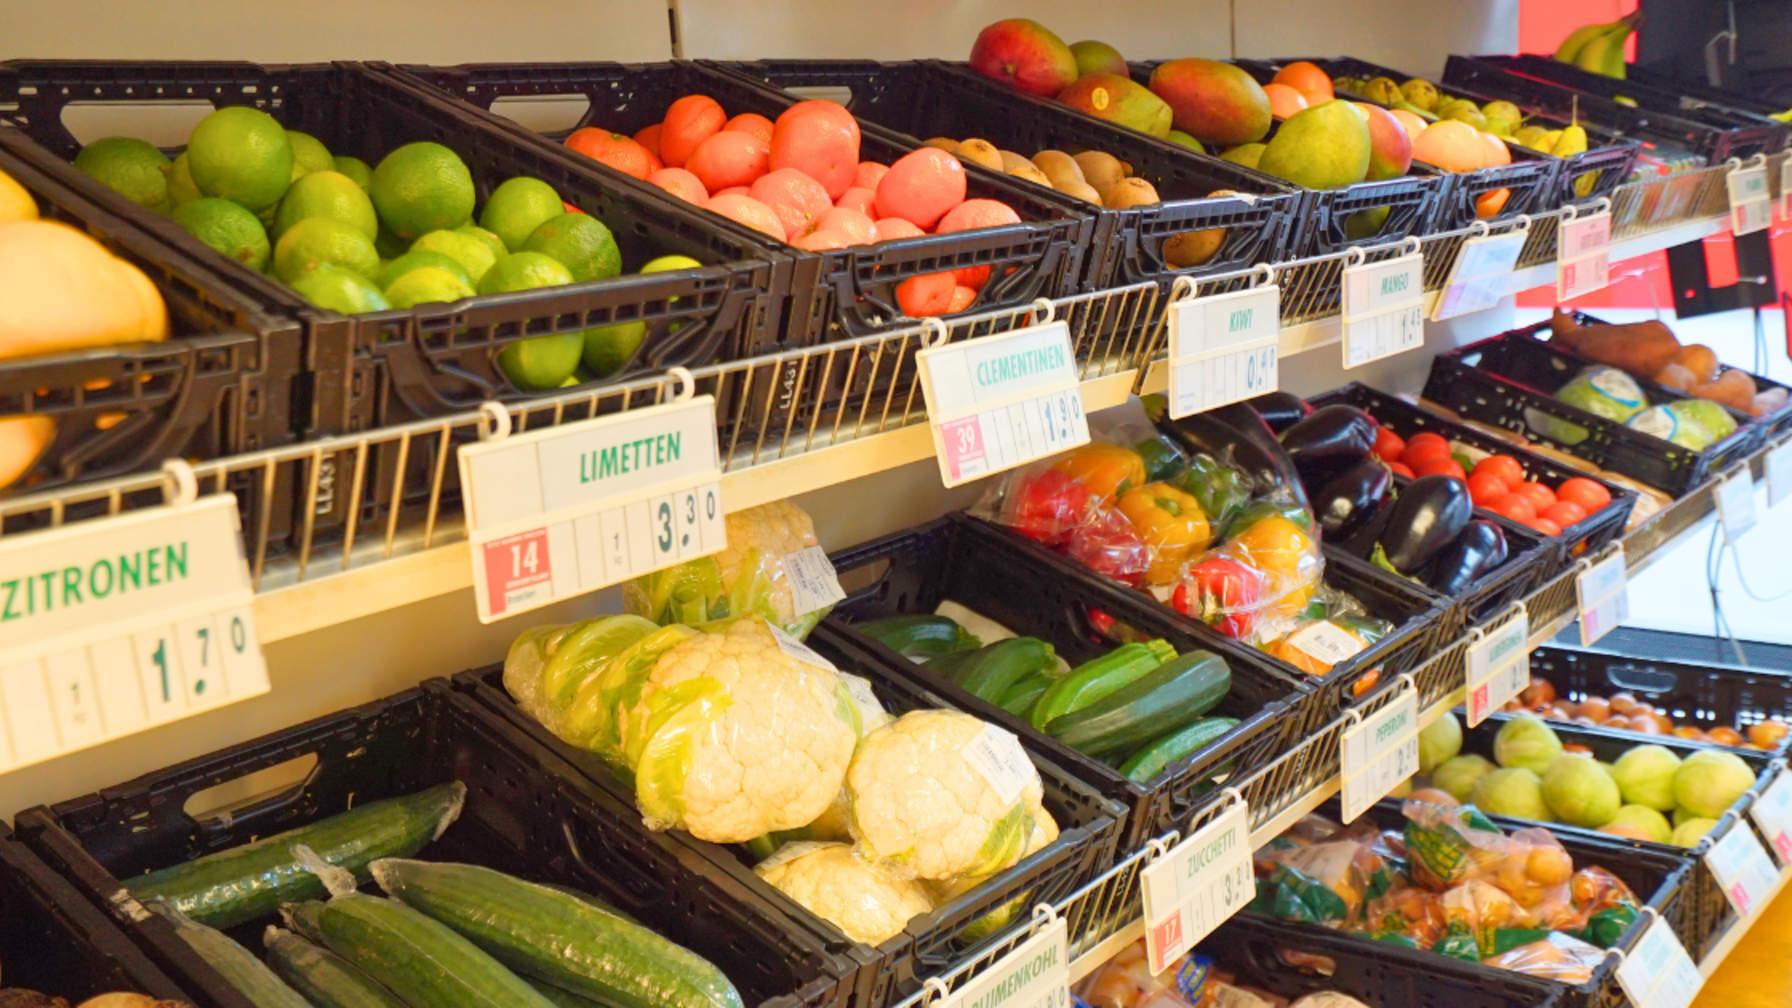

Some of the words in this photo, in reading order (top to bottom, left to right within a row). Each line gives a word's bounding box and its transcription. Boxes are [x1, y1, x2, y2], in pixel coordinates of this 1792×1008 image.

[976, 344, 1066, 387] CLEMENTINEN
[580, 430, 682, 485] LIMETTEN
[956, 424, 976, 454] 39
[510, 540, 540, 579] 14
[0, 541, 188, 623] ZITRONEN
[1187, 826, 1236, 878] ZUCCHETTI
[1165, 918, 1178, 946] 17
